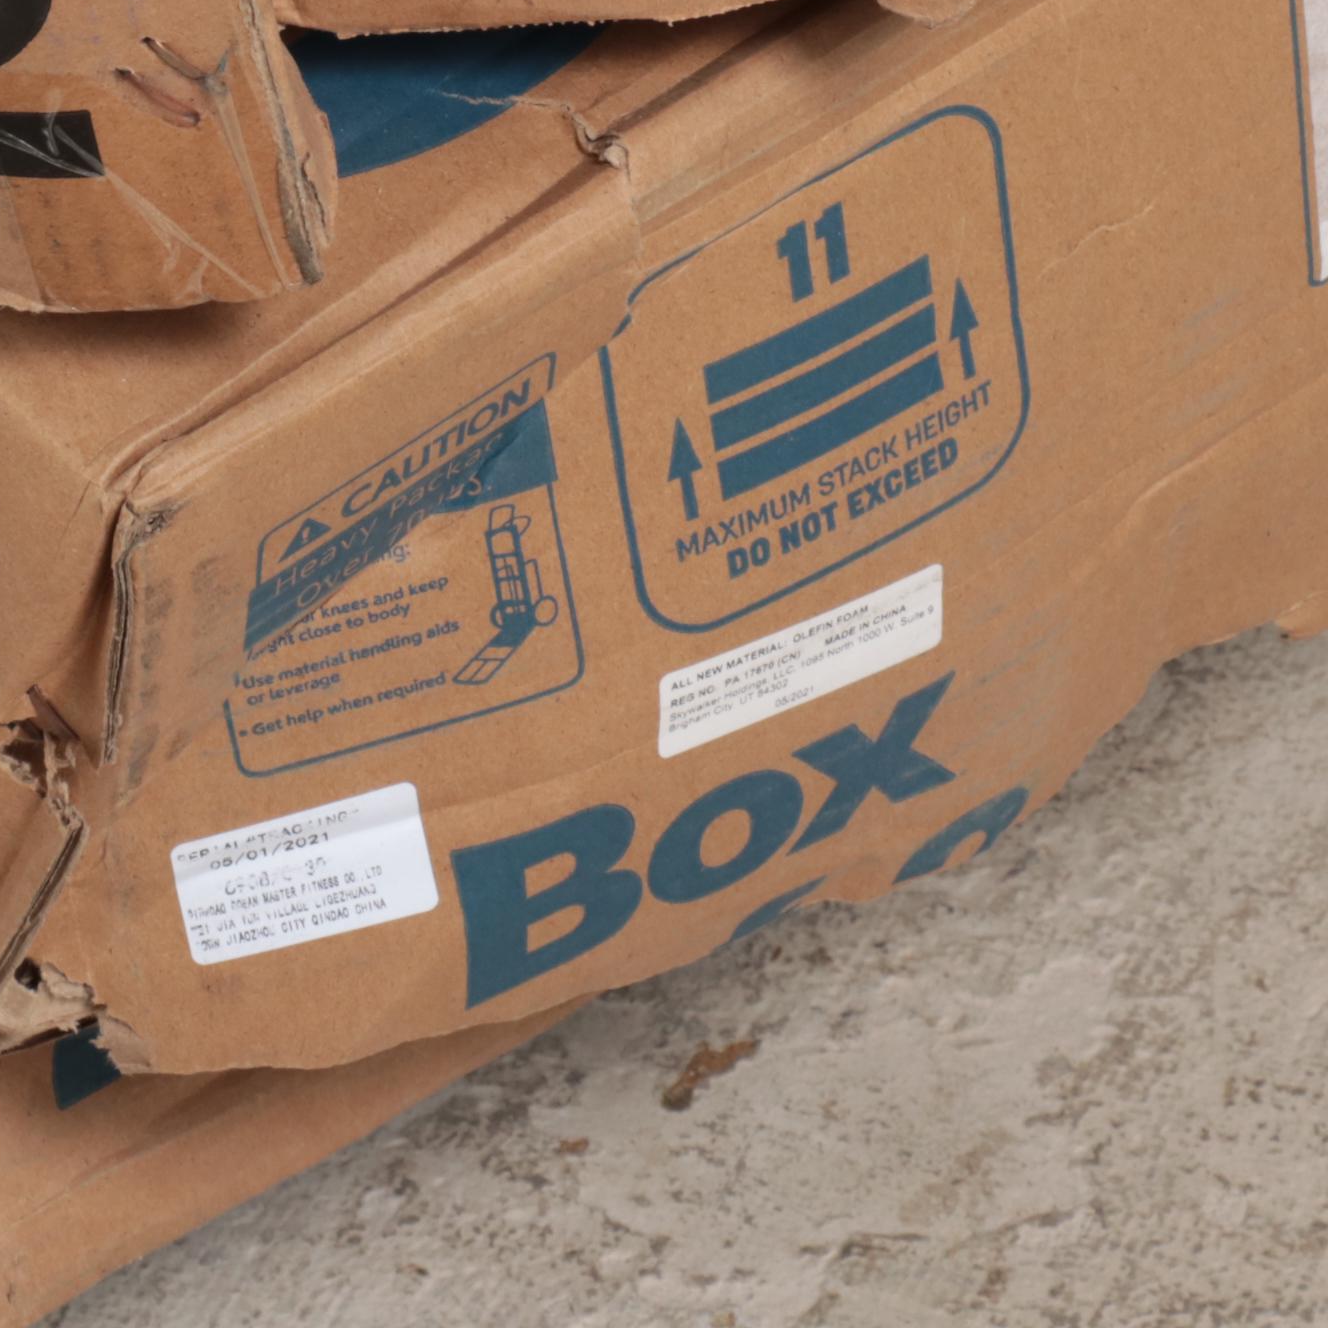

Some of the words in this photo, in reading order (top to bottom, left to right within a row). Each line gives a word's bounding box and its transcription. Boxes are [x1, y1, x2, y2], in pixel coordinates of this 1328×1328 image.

[774, 200, 851, 303] 11
[340, 377, 532, 518] CAUTION
[674, 482, 812, 564] MAXIMUM
[818, 434, 899, 498] STACK
[904, 379, 993, 451] HEIGHT
[726, 537, 771, 580] DO
[778, 499, 840, 555] NOT
[847, 435, 960, 522] EXCEED
[275, 517, 377, 596] Heavy
[296, 545, 375, 609] Over
[298, 621, 343, 643] close
[345, 613, 364, 630] to
[367, 602, 411, 624] body
[320, 597, 369, 619] knees
[373, 584, 405, 606] and
[408, 575, 449, 597] keep
[241, 670, 275, 690] Use
[277, 651, 346, 681] material
[349, 630, 423, 663] handling
[426, 618, 461, 640] aids
[670, 678, 693, 692] ALL
[696, 664, 723, 682] NEW
[792, 619, 834, 644] OLEFIN
[836, 604, 870, 625] FOAM
[670, 692, 695, 709] REG
[824, 625, 856, 646] MADE
[872, 604, 907, 625] CHINA
[246, 691, 266, 706] or
[268, 672, 341, 701] leverage
[251, 718, 284, 737] Get
[285, 706, 325, 728] help
[327, 694, 373, 716] when
[376, 672, 447, 703] required
[210, 831, 331, 870] 05/01/2021
[449, 670, 956, 1009] Box
